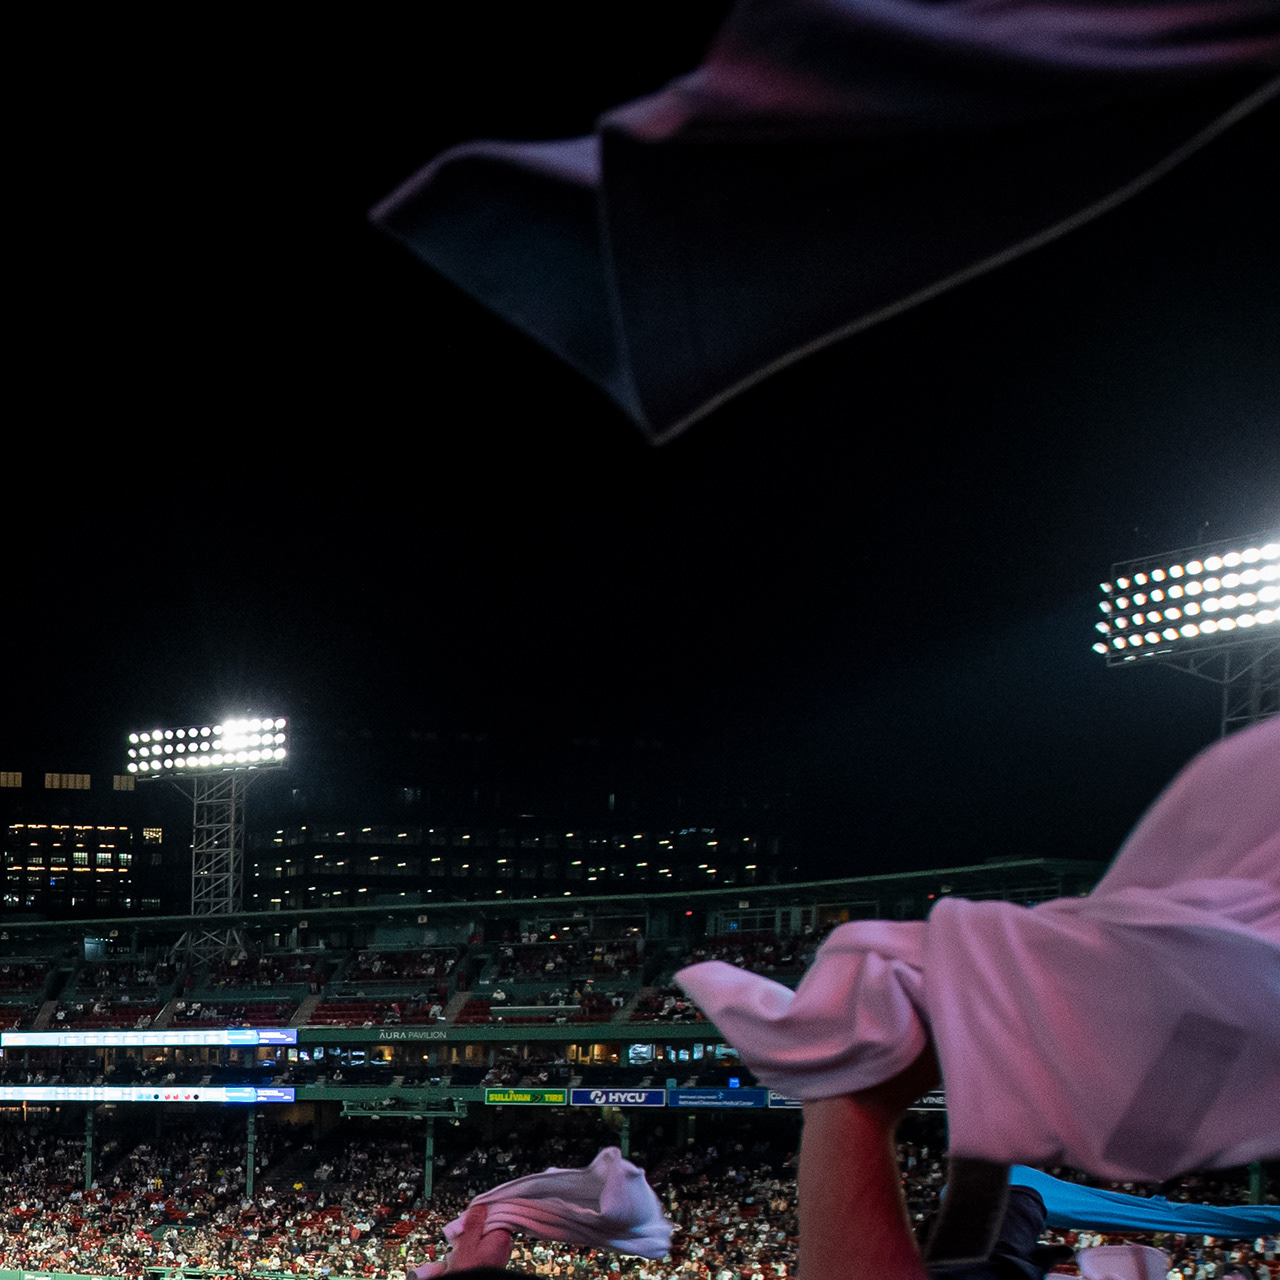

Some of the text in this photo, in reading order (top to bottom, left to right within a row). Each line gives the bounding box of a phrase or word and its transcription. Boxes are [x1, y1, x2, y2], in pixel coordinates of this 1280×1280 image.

[408, 1031, 447, 1039] PAVILION
[489, 1090, 564, 1102] SULLIVAN TIRE
[608, 1092, 646, 1103] HYCU
